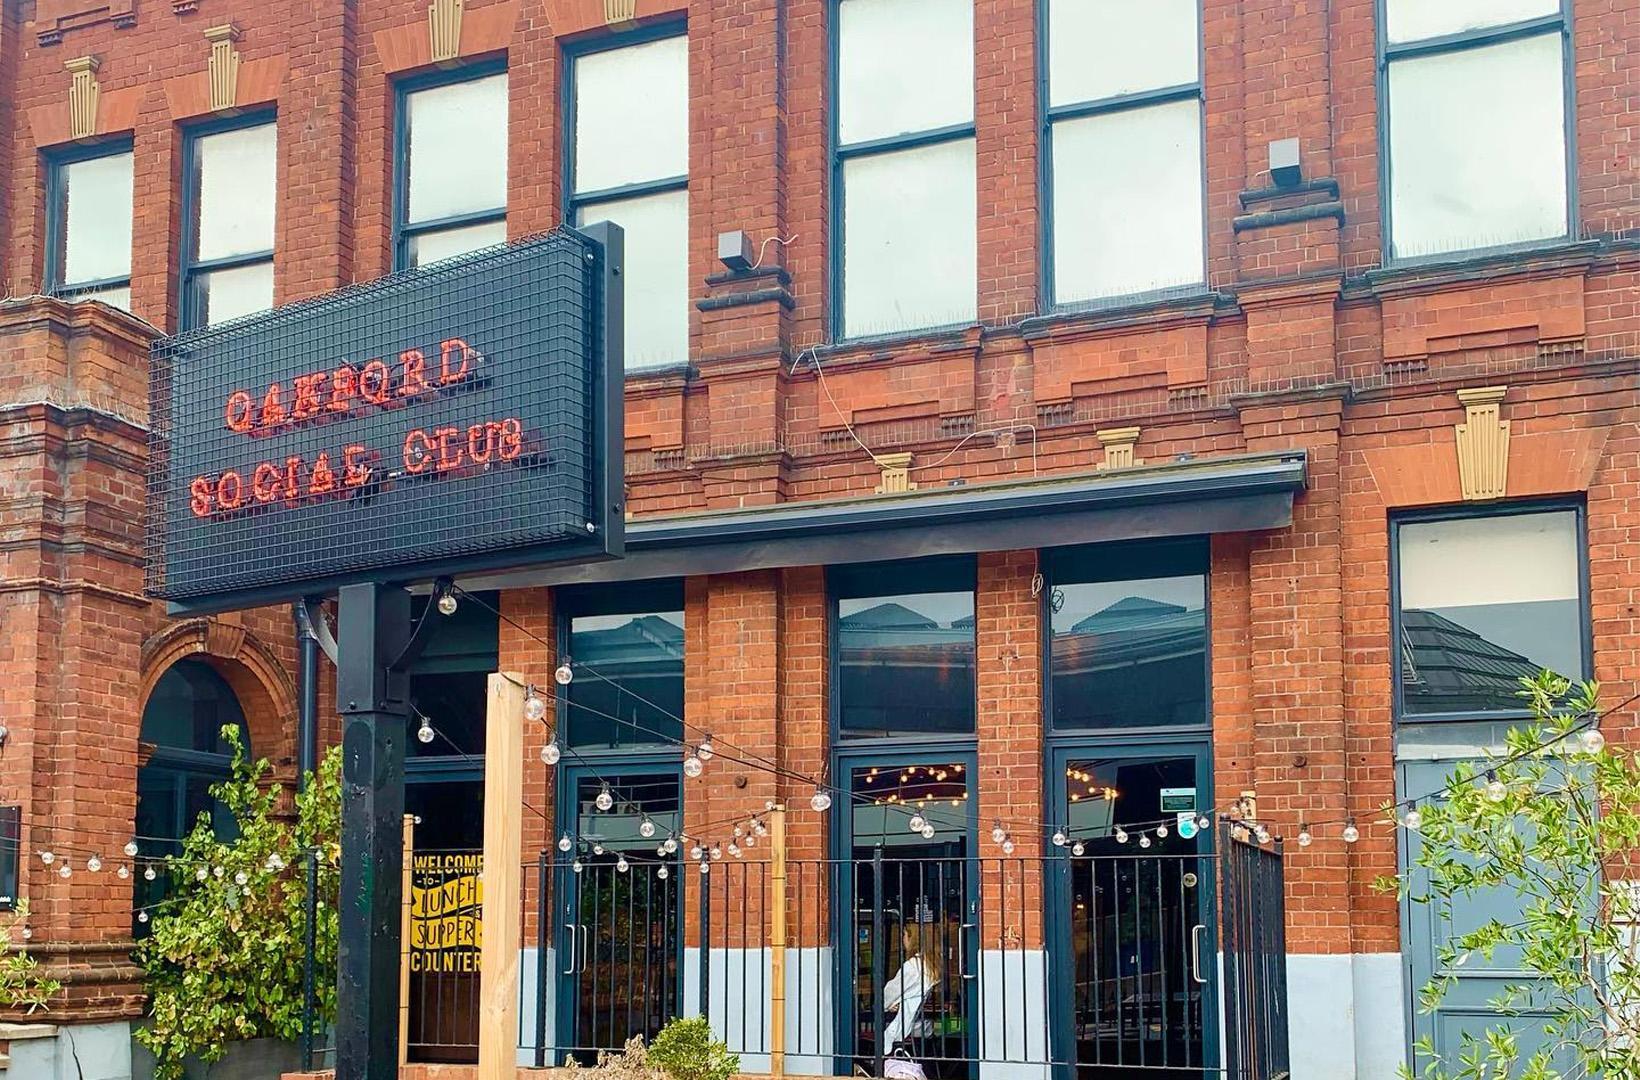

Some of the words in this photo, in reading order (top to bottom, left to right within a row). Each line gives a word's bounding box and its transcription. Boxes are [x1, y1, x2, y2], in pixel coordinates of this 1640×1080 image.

[402, 417, 523, 475] CLUB
[414, 855, 484, 874] WELCOME
[421, 879, 477, 914] LUNCH
[417, 920, 475, 945] SUPPER
[410, 951, 482, 973] COUNTER
